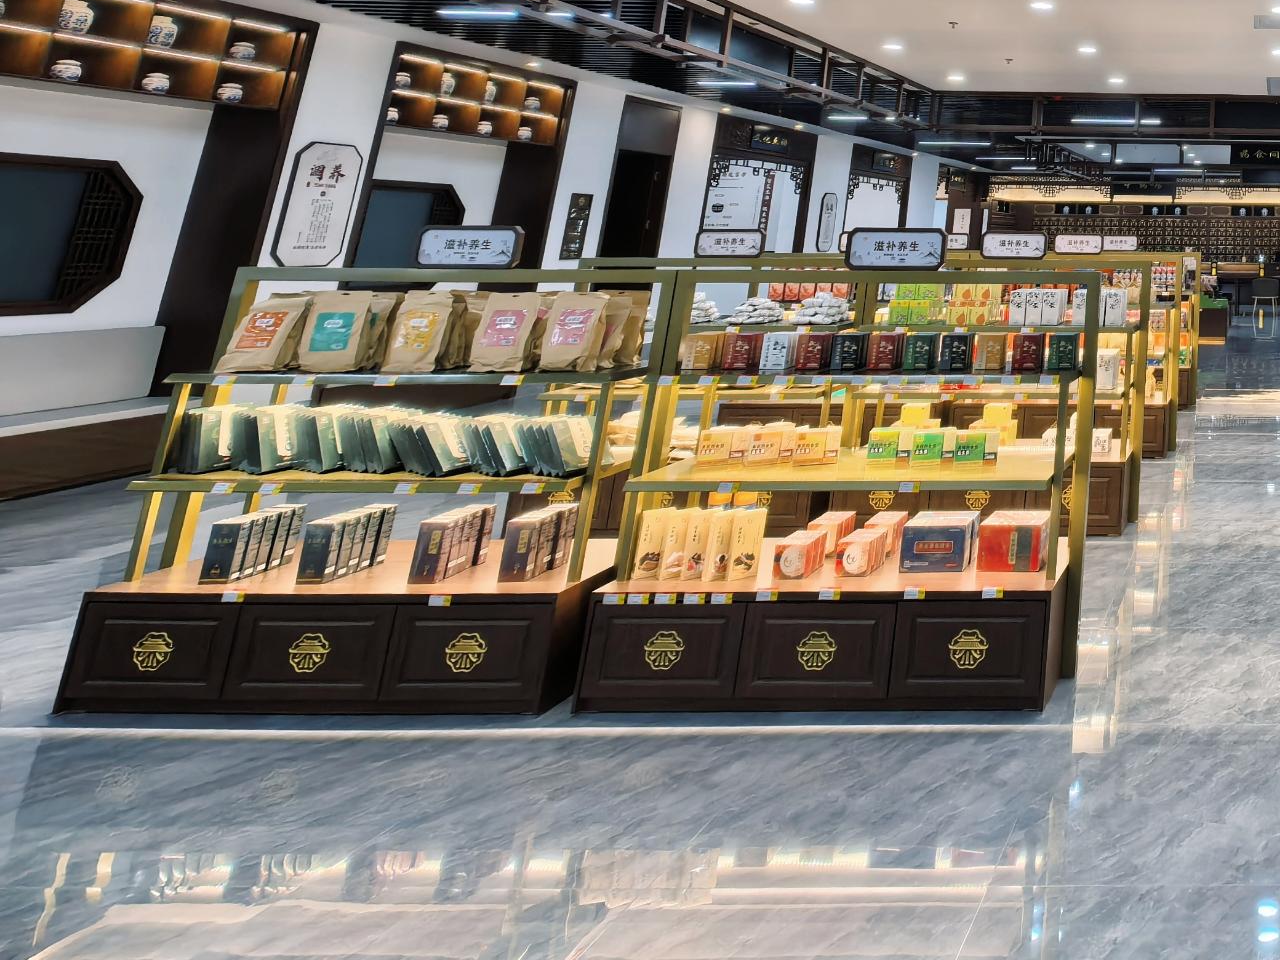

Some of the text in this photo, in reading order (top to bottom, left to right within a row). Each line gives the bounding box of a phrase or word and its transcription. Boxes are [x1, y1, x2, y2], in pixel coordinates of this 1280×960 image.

[444, 238, 492, 251] 滋补养生
[873, 240, 920, 252] 滋补养生
